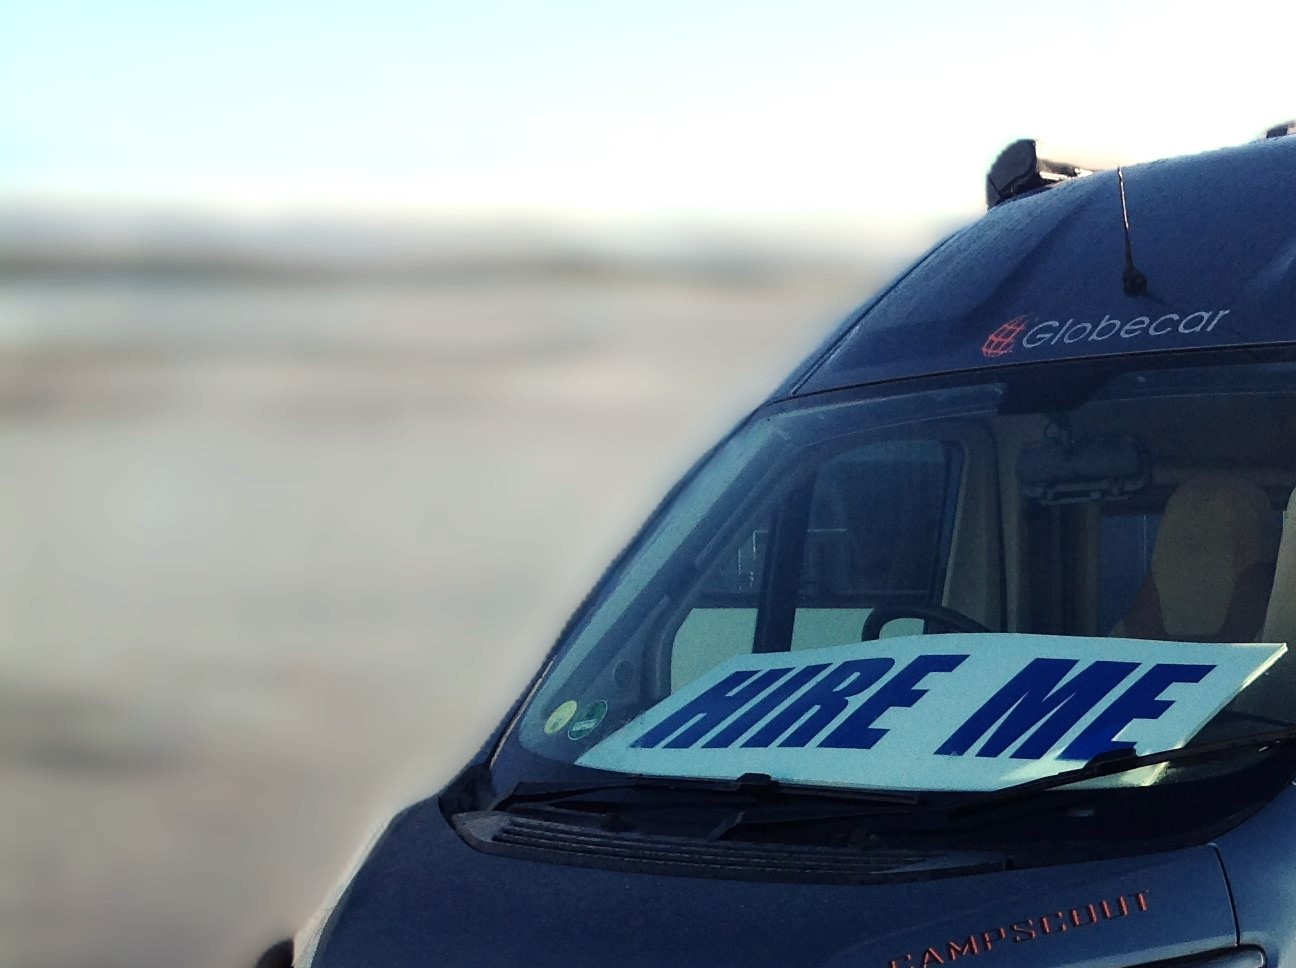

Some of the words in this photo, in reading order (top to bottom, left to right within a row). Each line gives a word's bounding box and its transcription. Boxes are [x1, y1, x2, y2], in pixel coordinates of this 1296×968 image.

[1021, 308, 1230, 349] Globecar
[629, 654, 971, 749] HIRE
[935, 657, 1217, 760] ME
